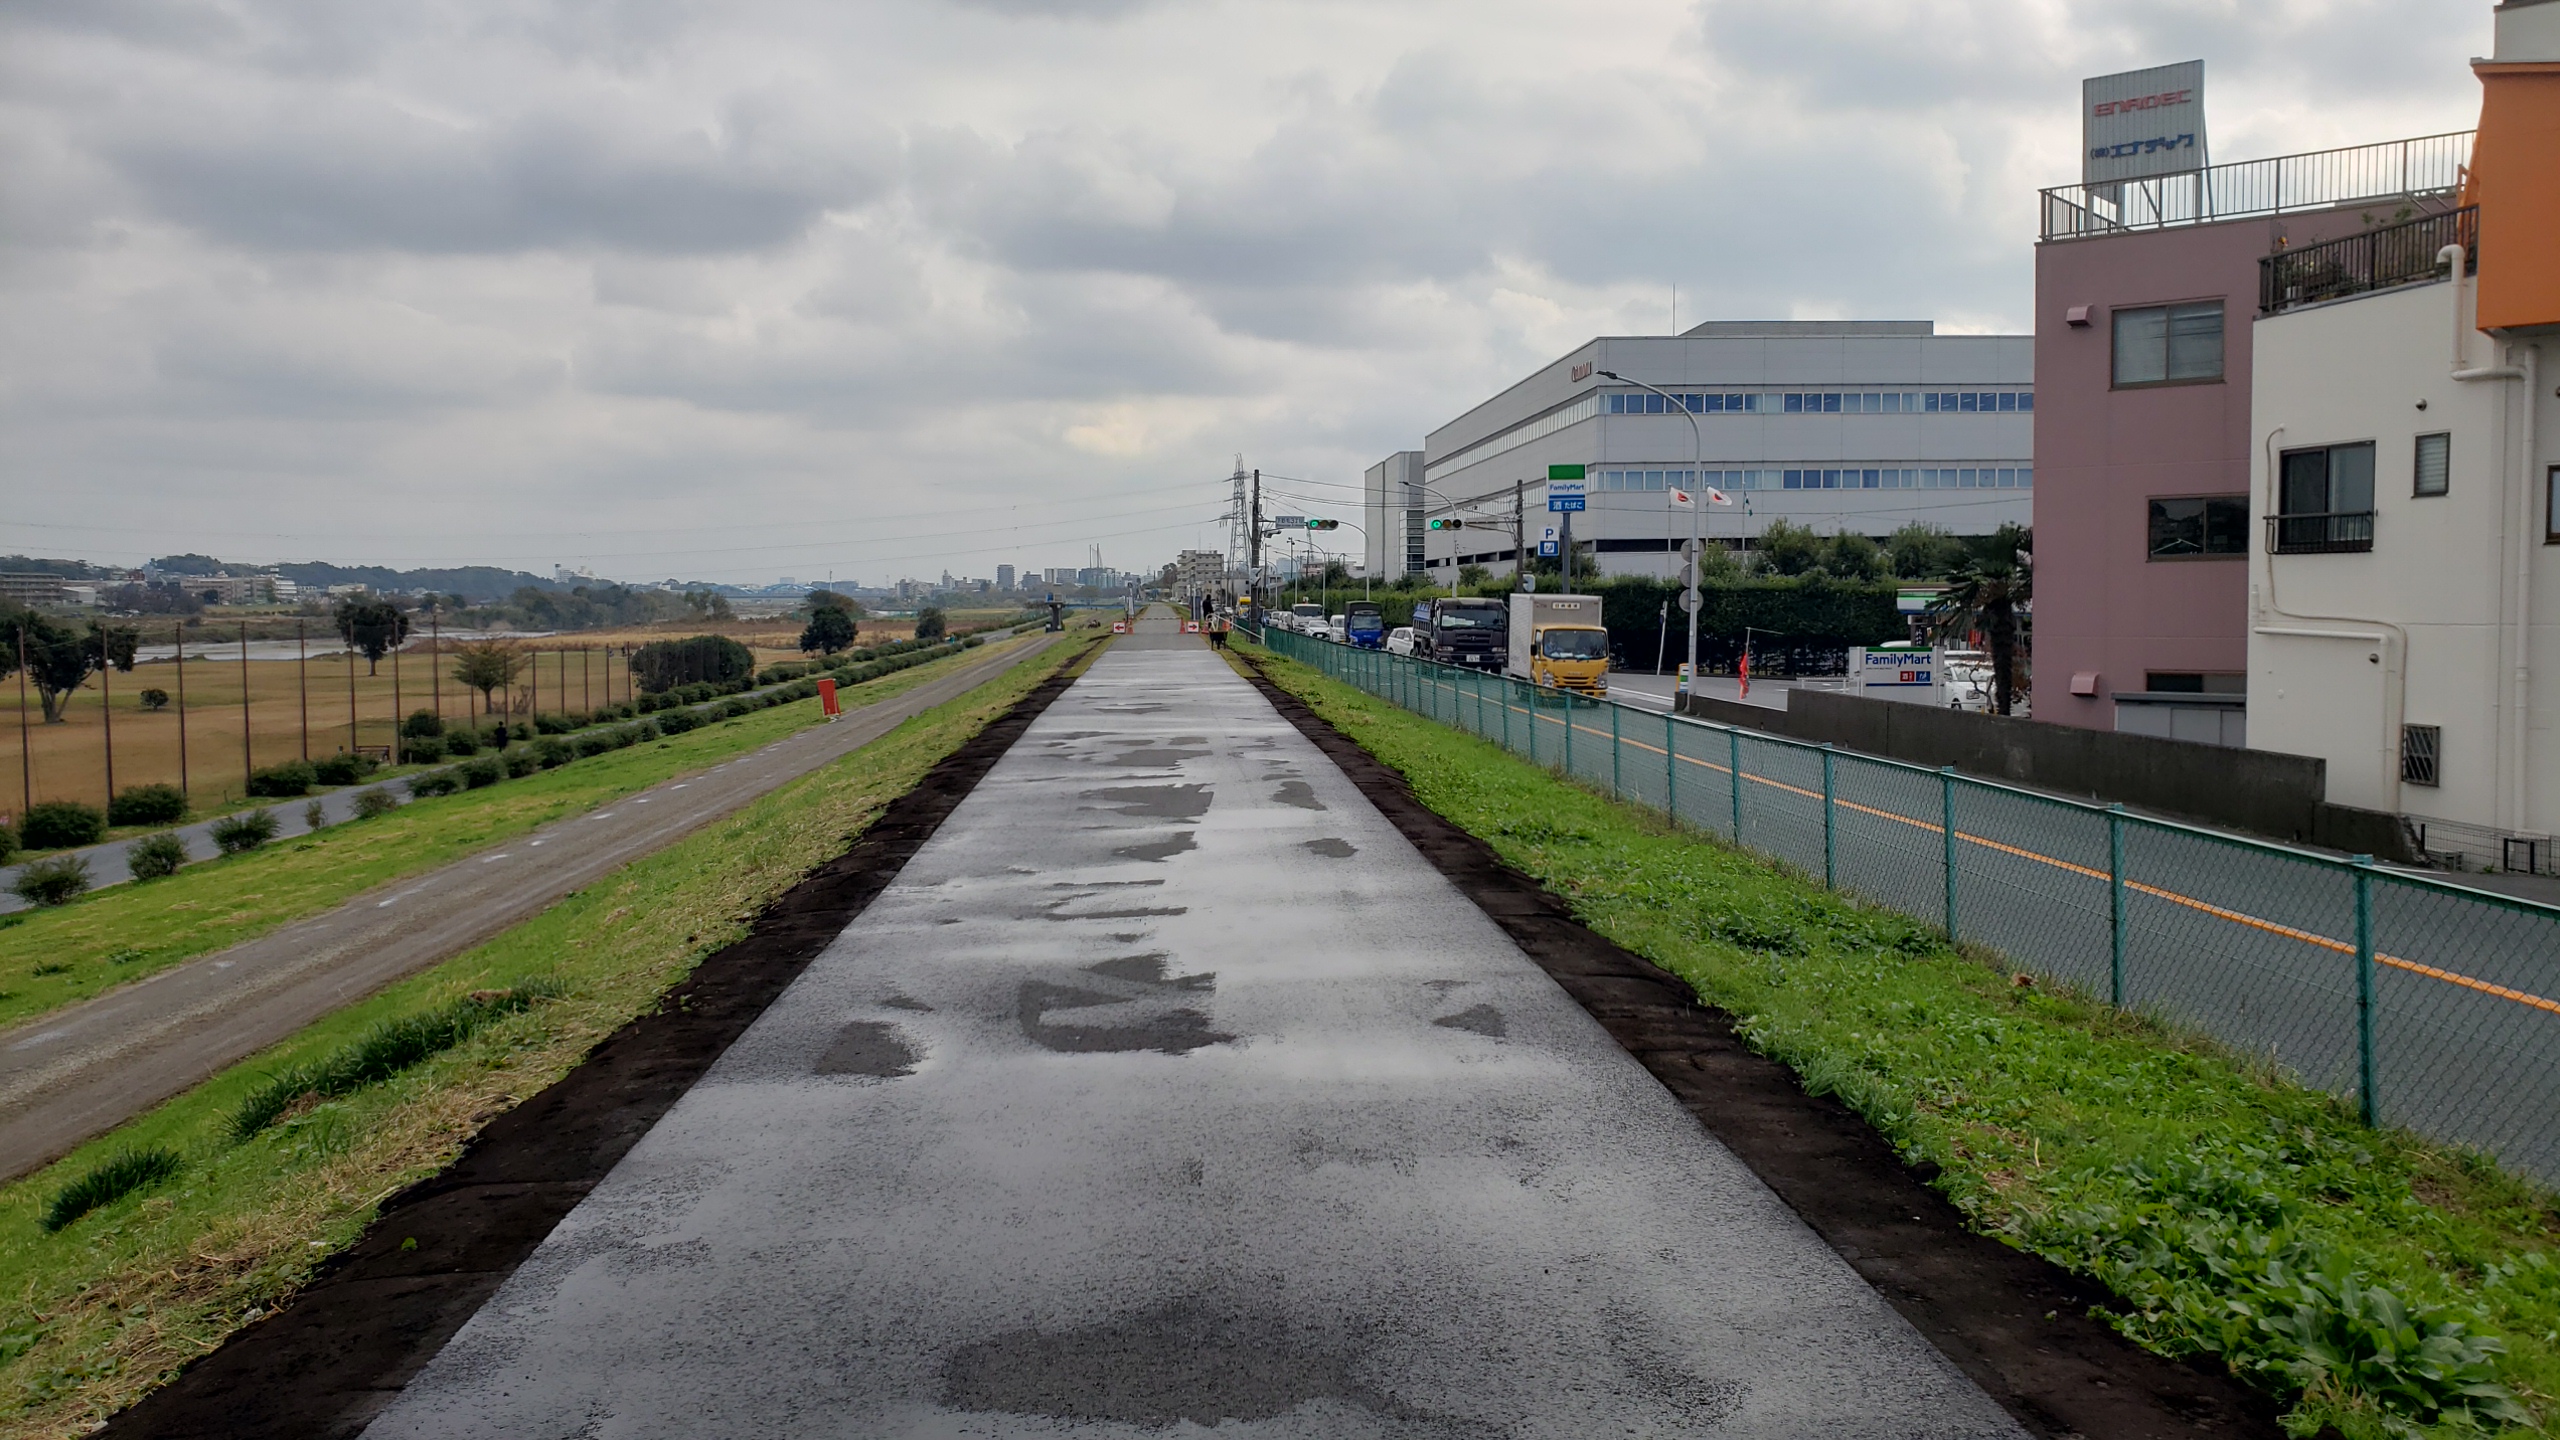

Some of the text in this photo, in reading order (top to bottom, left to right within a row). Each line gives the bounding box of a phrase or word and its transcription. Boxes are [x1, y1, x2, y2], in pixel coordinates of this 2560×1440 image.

[2094, 89, 2192, 116] ENADEC
[1550, 484, 1584, 492] FamilyMart
[1564, 501, 1583, 510] たばこ
[1546, 528, 1554, 539] P
[1865, 653, 1932, 667] FamilyMart
